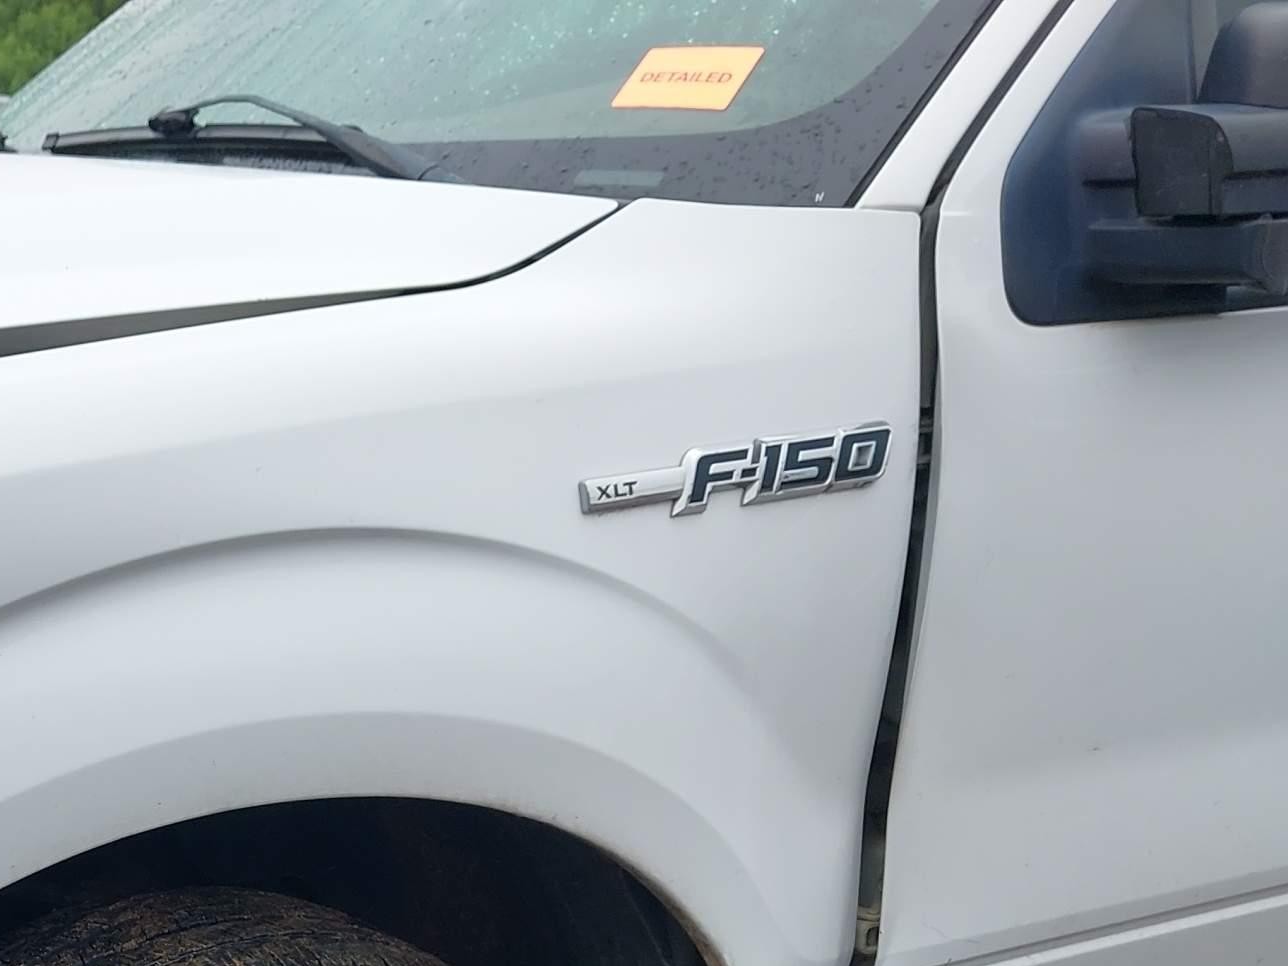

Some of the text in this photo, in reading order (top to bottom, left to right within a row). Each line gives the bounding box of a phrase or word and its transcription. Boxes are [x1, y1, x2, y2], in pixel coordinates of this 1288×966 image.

[639, 71, 733, 84] DETAILED
[596, 424, 893, 513] XLT F-150
